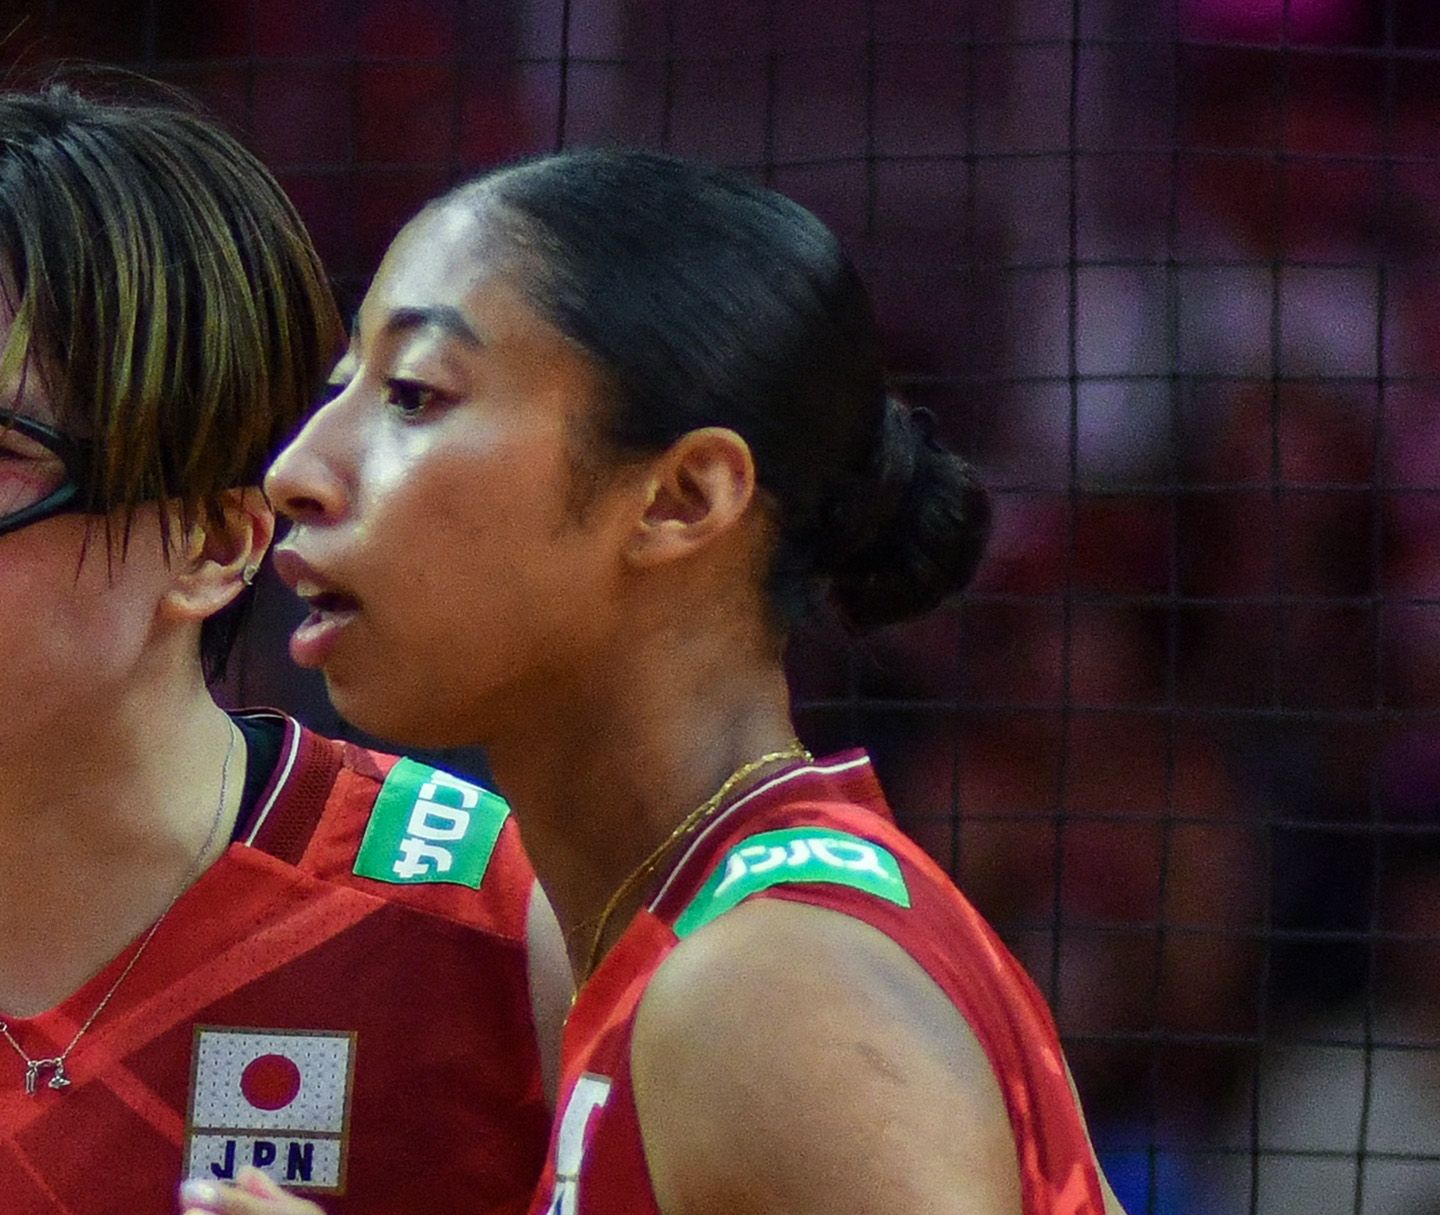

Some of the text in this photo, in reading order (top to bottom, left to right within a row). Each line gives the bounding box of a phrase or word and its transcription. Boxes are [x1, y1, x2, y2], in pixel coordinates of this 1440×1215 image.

[392, 770, 486, 878] サロン
[211, 1140, 314, 1181] JPN
